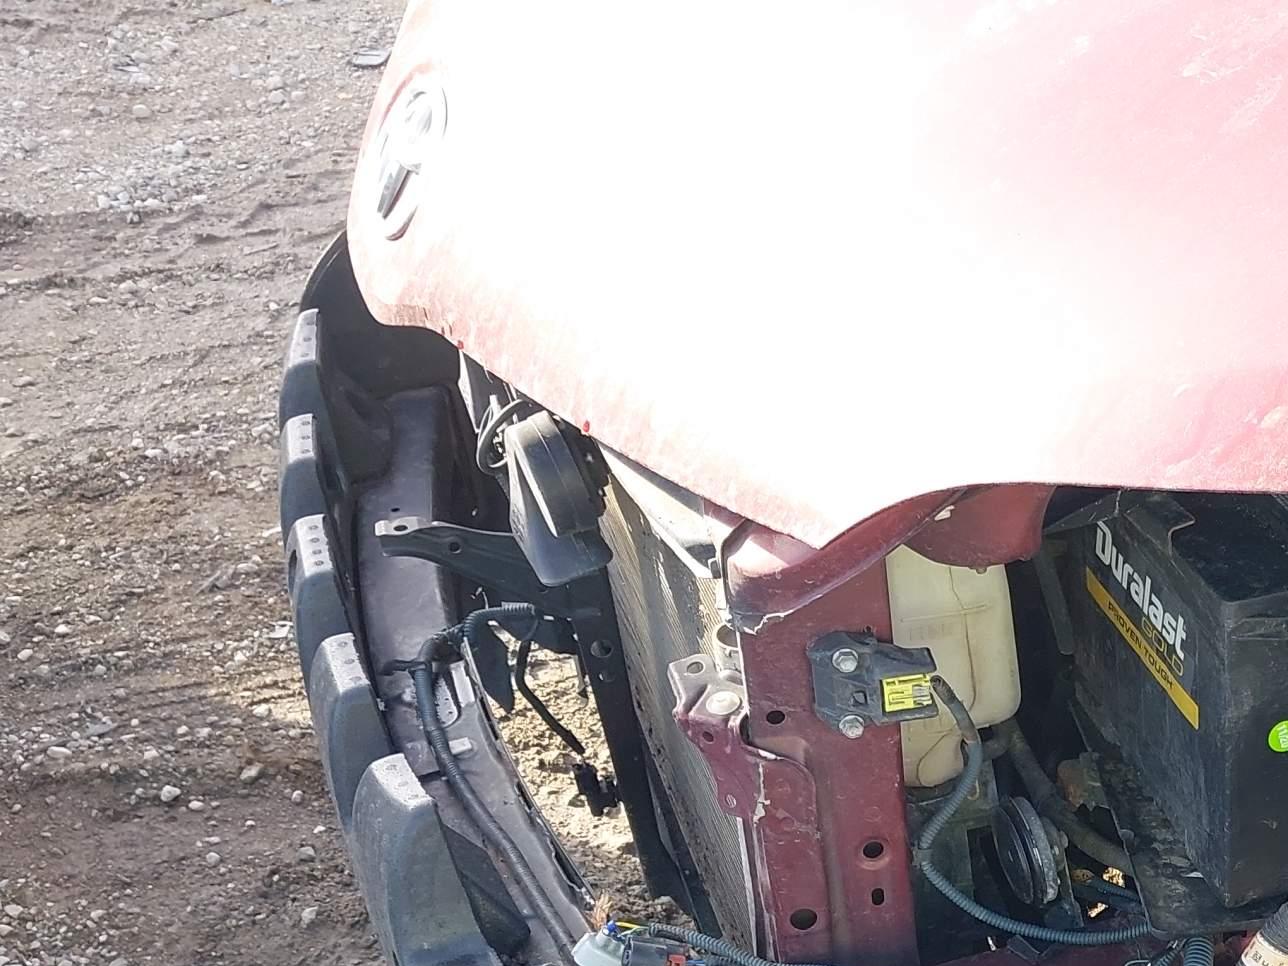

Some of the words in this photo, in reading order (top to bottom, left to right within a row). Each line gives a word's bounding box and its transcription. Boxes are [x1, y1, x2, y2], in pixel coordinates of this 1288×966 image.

[1095, 520, 1187, 661] Duralast
[1108, 601, 1142, 649] PROVEN
[1142, 648, 1174, 690] TOUGH
[1141, 616, 1184, 676] GOLD
